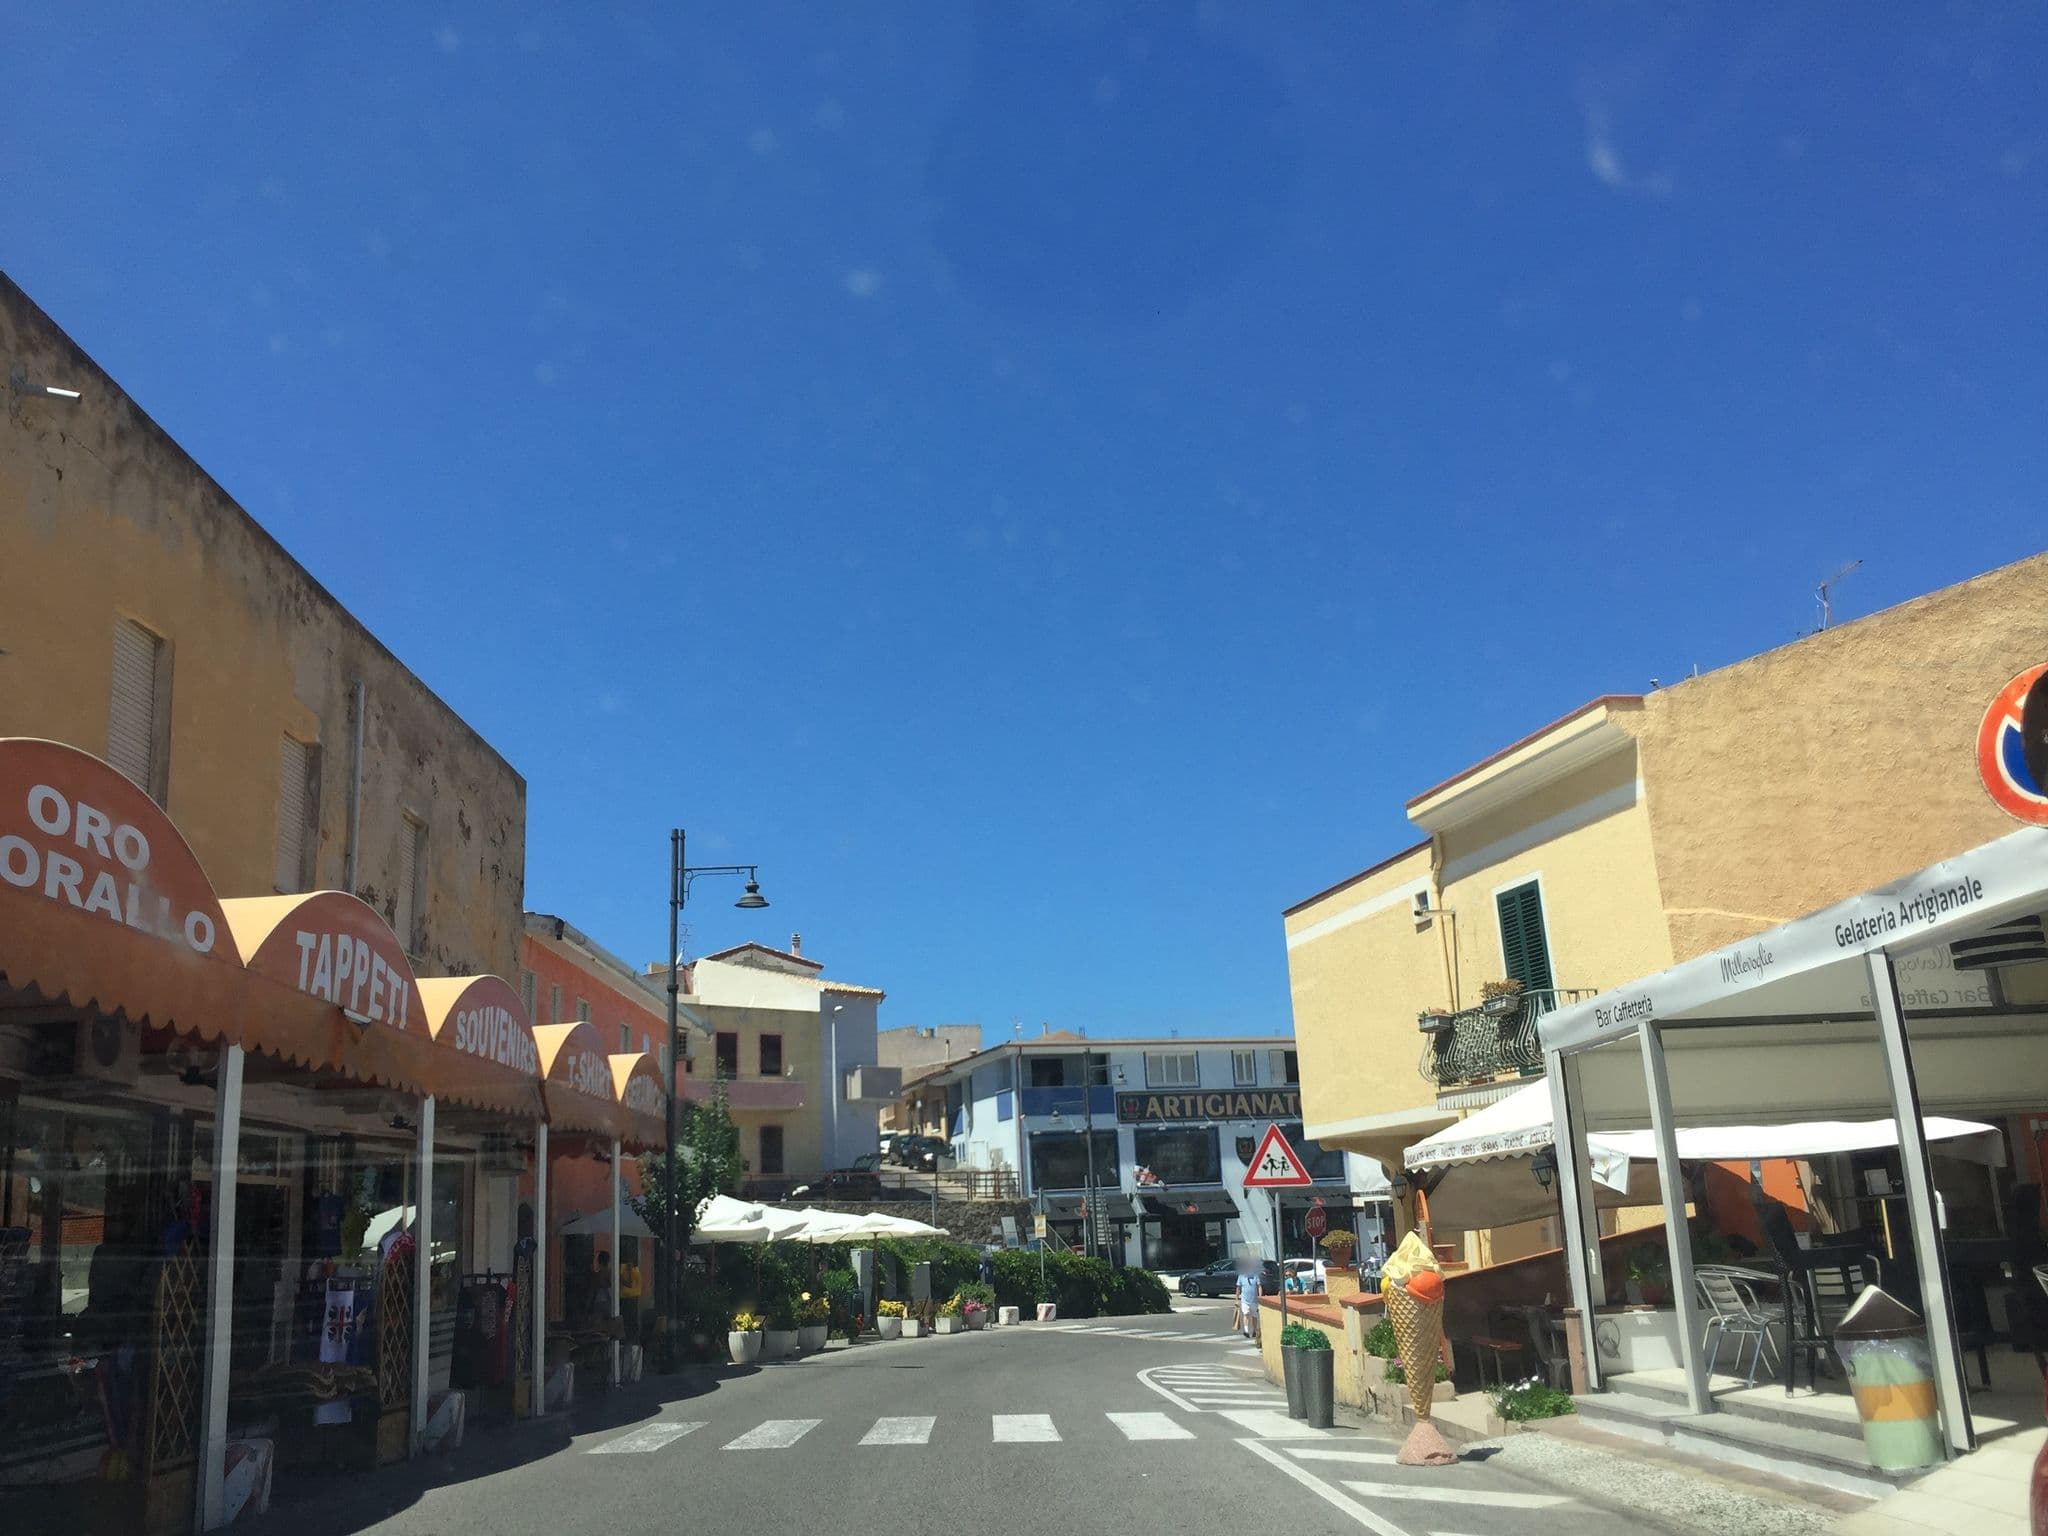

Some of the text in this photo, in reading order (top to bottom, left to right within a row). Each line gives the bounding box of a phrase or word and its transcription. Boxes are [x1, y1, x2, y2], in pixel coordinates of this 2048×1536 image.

[27, 784, 150, 872] ORO
[1835, 876, 1983, 948] Gelateria Artigianale
[296, 930, 409, 1030] TAPPETI
[1720, 942, 1774, 984] Millevoglie
[1595, 994, 1653, 1028] Bar Caffetteria
[456, 1006, 537, 1075] SOUVENIRS
[1146, 1093, 1300, 1118] ARTIGIANAT
[1306, 1215, 1325, 1229] STOP
